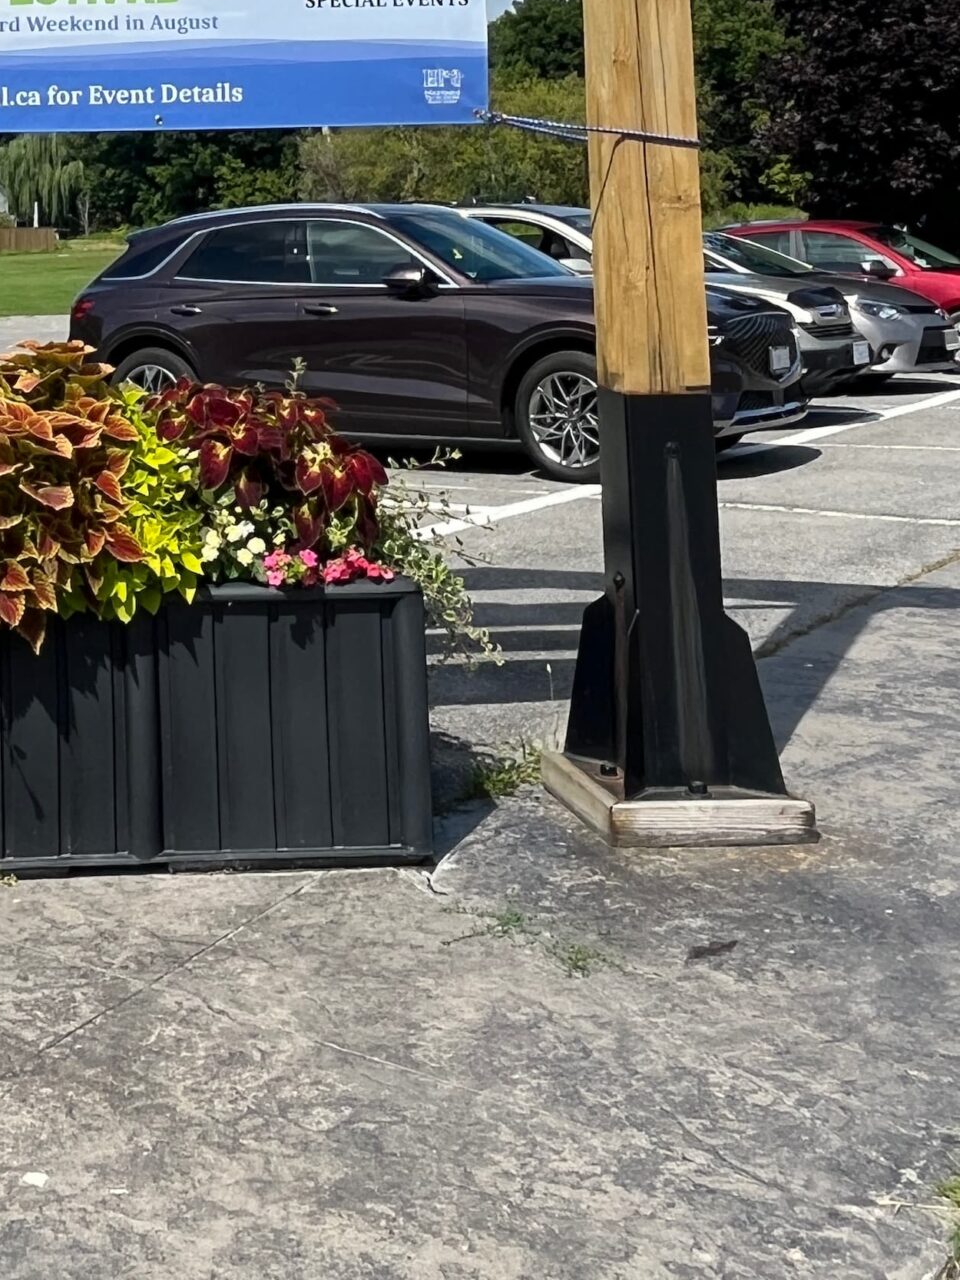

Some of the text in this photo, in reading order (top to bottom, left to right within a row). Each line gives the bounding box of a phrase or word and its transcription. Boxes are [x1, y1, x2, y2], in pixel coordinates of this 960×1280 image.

[26, 15, 119, 32] Weekend
[126, 15, 145, 31] in
[150, 15, 219, 34] August
[47, 85, 83, 105] for
[89, 83, 155, 105] Event
[161, 82, 244, 104] Details
